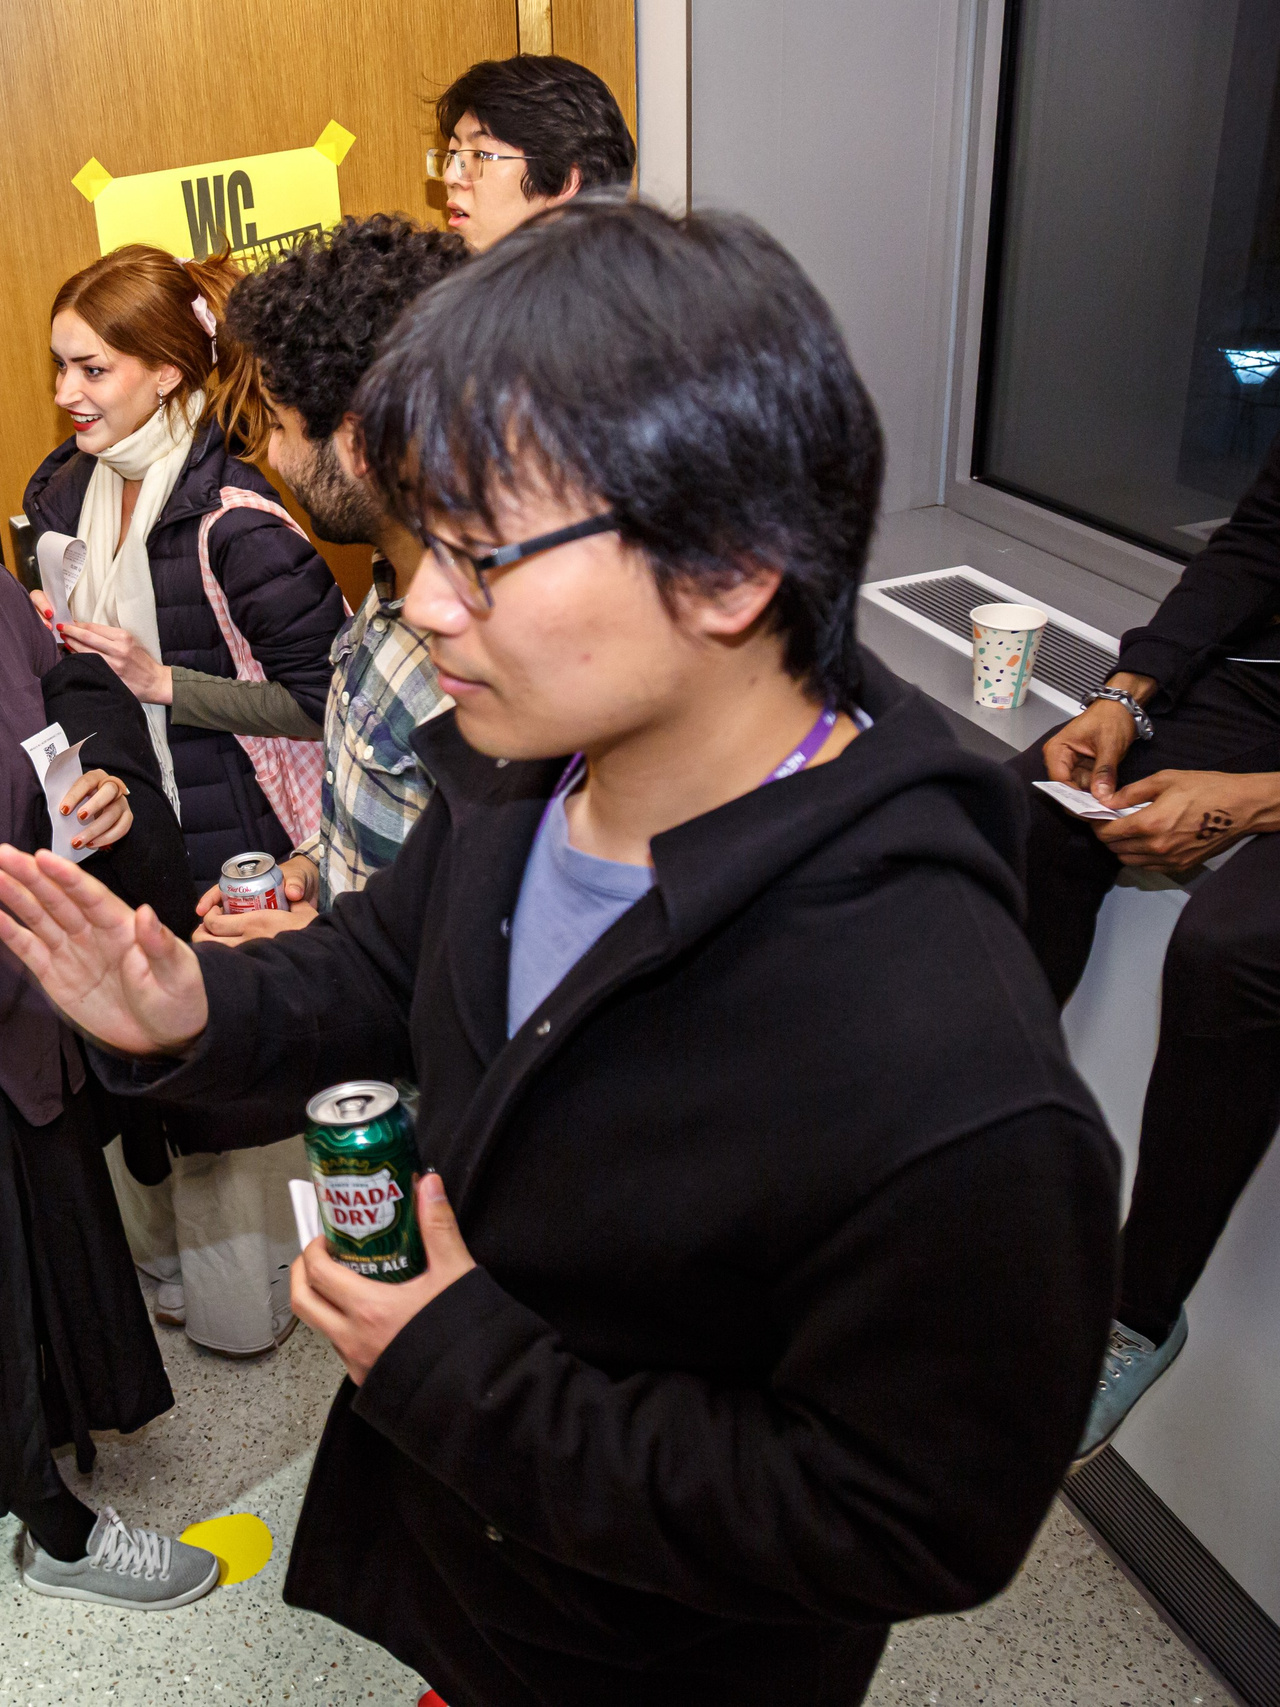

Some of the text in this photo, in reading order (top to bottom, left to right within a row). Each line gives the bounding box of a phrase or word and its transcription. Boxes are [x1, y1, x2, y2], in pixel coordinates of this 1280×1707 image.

[181, 169, 258, 261] WC
[333, 1207, 379, 1226] DRY
[383, 1255, 409, 1273] ALE
